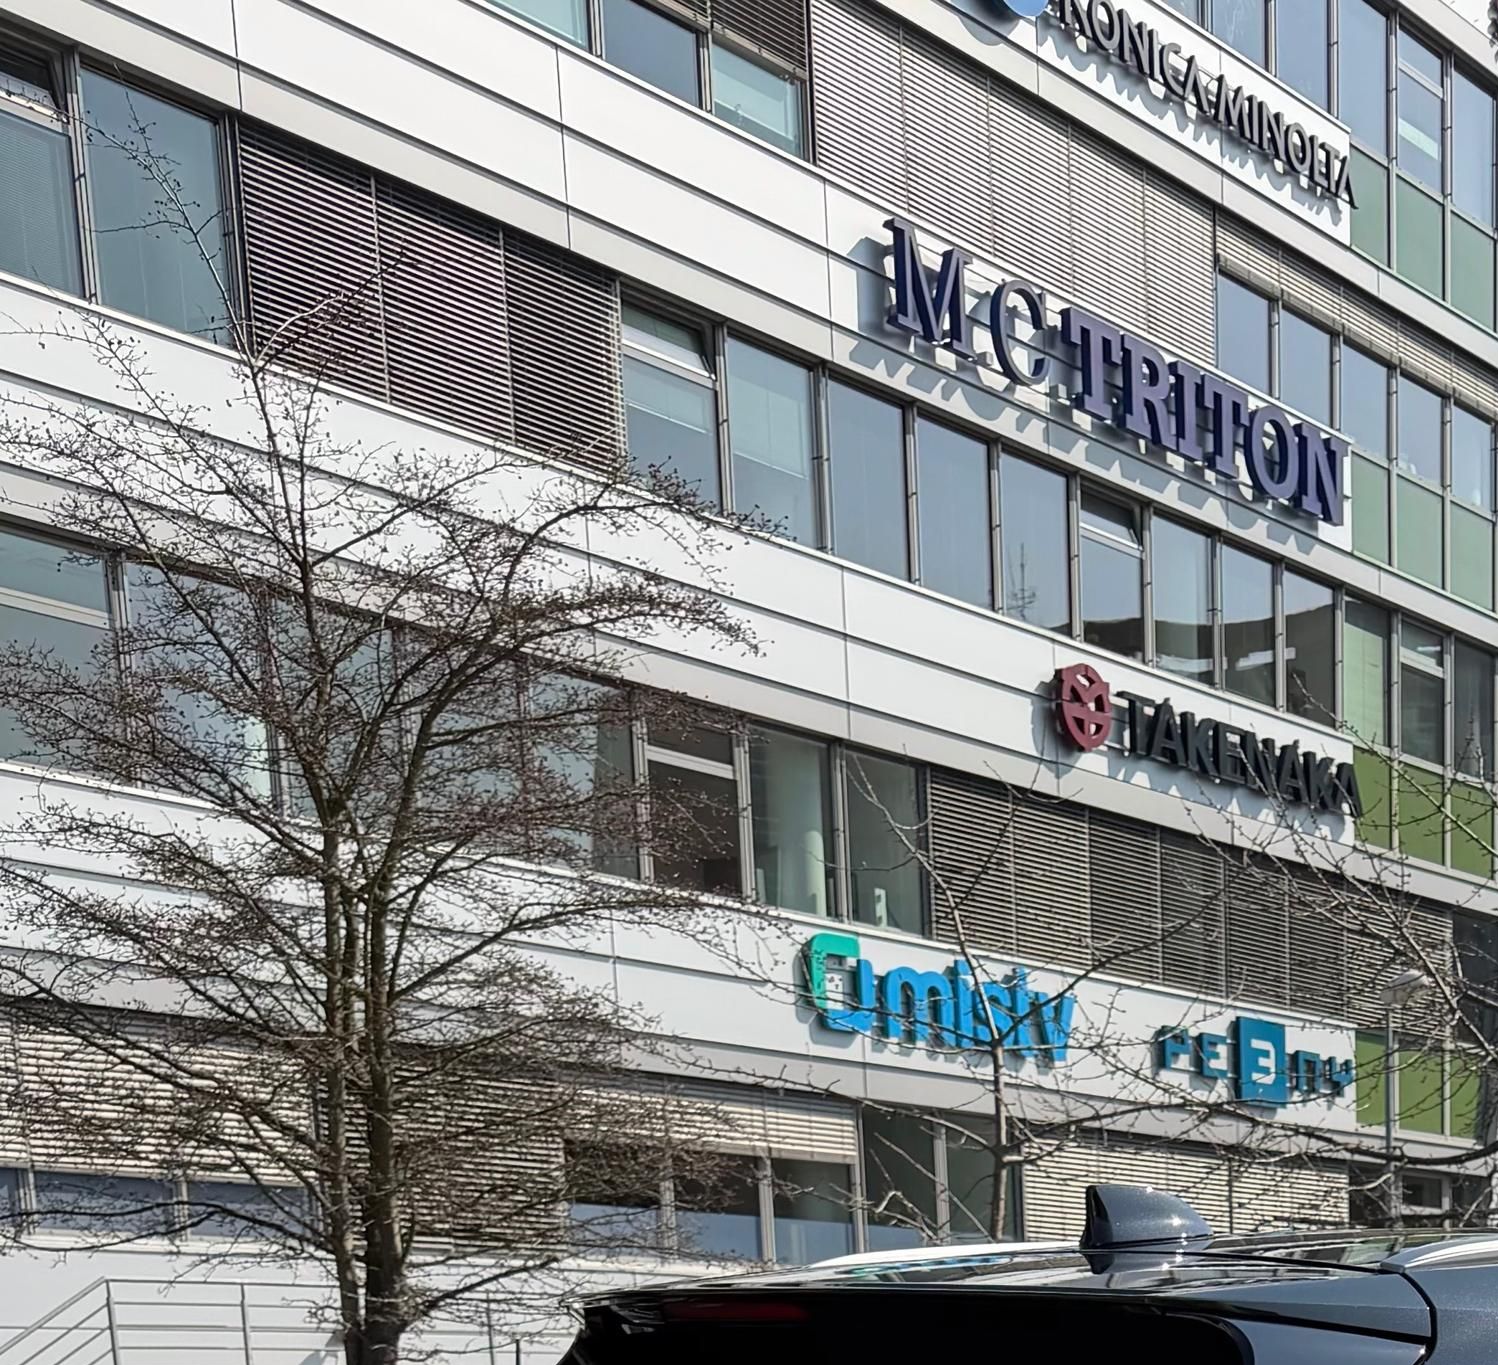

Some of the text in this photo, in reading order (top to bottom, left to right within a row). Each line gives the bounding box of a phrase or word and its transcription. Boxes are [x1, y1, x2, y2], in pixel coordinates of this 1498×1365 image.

[1056, 0, 1359, 209] KONICA MINOLTA
[1116, 691, 1362, 819] TAKENAKA
